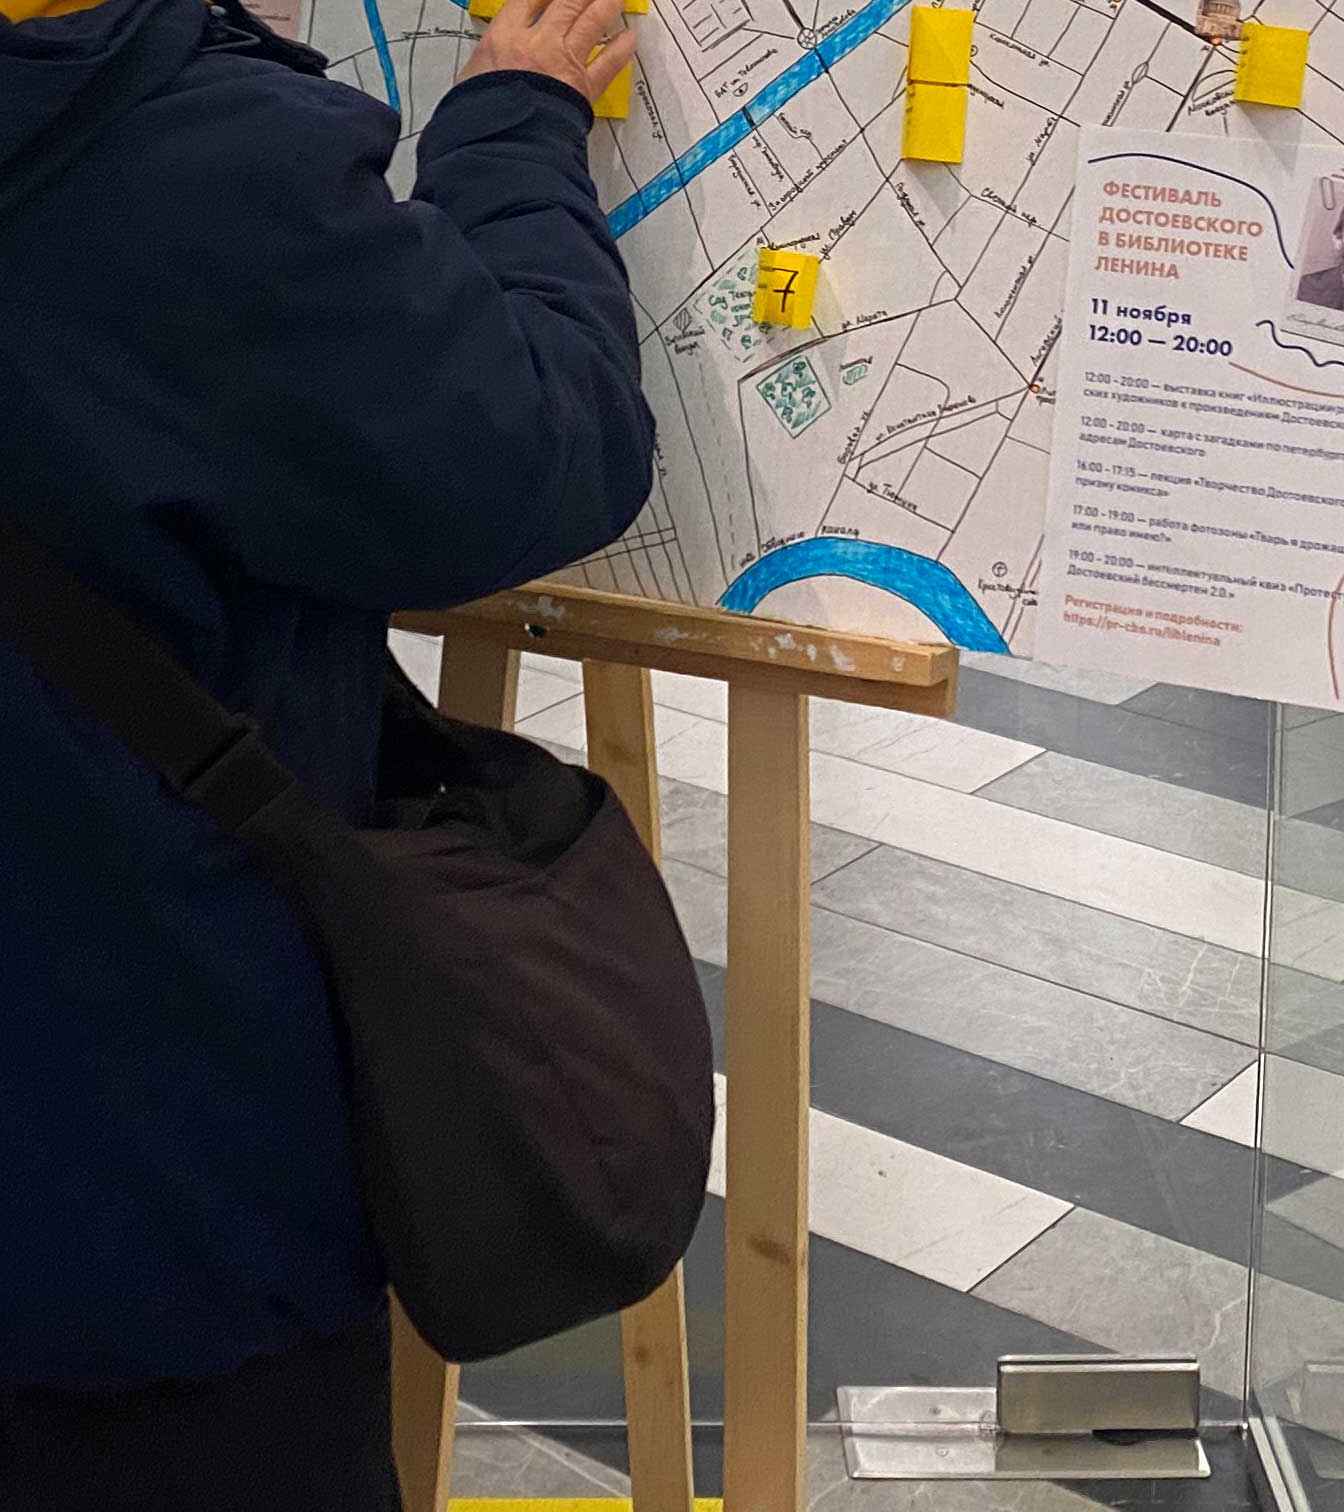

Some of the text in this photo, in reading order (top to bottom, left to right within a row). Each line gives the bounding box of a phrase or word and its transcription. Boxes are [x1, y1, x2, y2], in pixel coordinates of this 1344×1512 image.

[1103, 180, 1223, 208] ФЕСТИВАЛЬ
[1099, 206, 1264, 238] ДОСТОЕВСКОГО
[1098, 231, 1249, 262] В БИБЛИОТЕКЕ
[1094, 256, 1180, 279] ЛЕНИНА
[760, 266, 799, 313] 7
[1091, 298, 1192, 328] 11 ноября
[1089, 324, 1143, 346] 12:00
[1172, 334, 1233, 357] 20:00
[1085, 371, 1112, 385] 12:00
[1120, 375, 1150, 388] 20:00
[1163, 383, 1216, 398] выставка
[1080, 415, 1107, 429] 12:00
[1116, 420, 1145, 433] 20:00
[1161, 428, 1192, 441] карта
[1127, 437, 1206, 457] Достоевского
[1112, 464, 1136, 478] 17:15
[1072, 504, 1099, 518] 17:00
[1108, 509, 1135, 523] 19:00
[1149, 517, 1189, 531] работа
[1066, 564, 1141, 586] Достоевский
[1068, 548, 1095, 563] 19:00
[1104, 554, 1134, 568] 20:00
[1259, 580, 1287, 592] квиз
[1064, 594, 1143, 617] Регистрация
[1154, 610, 1244, 633] подробности:
